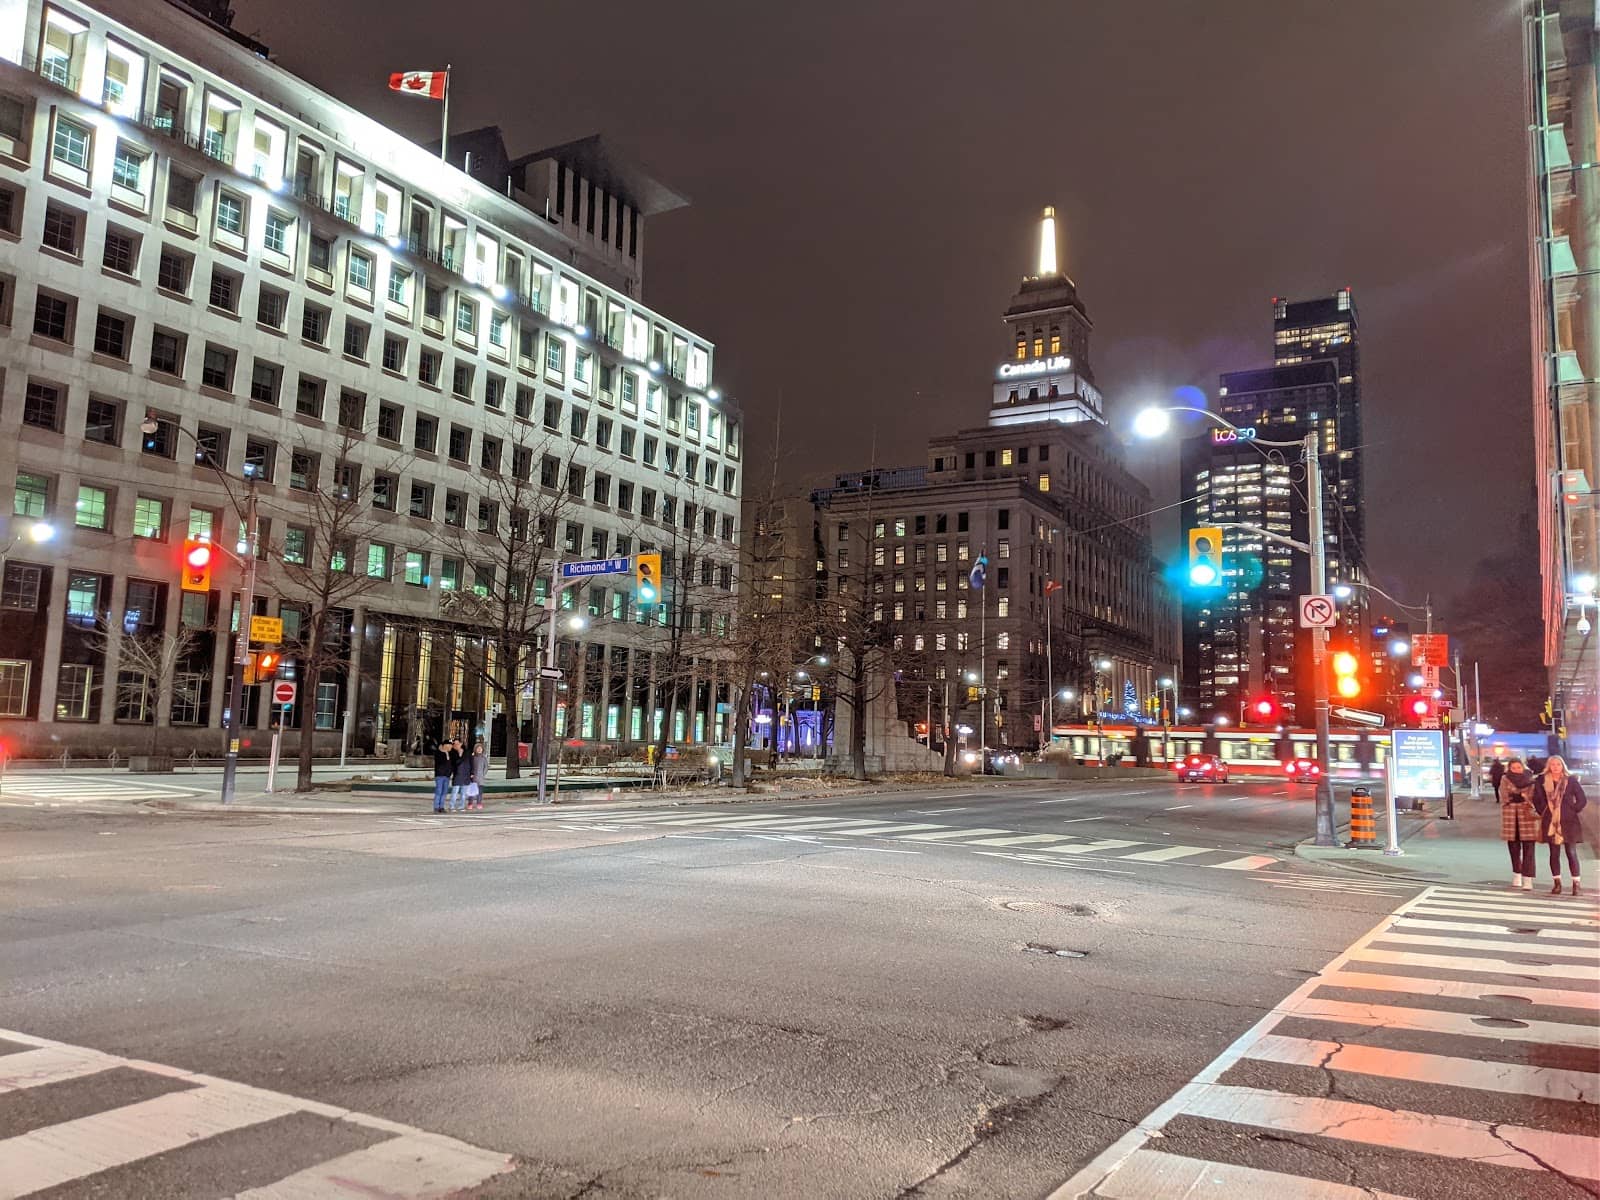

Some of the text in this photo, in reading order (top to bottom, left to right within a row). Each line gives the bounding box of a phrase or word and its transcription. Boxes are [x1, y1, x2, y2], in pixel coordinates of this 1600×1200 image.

[1000, 356, 1071, 376] Canada Life
[570, 561, 606, 574] Richmond
[615, 560, 622, 569] W
